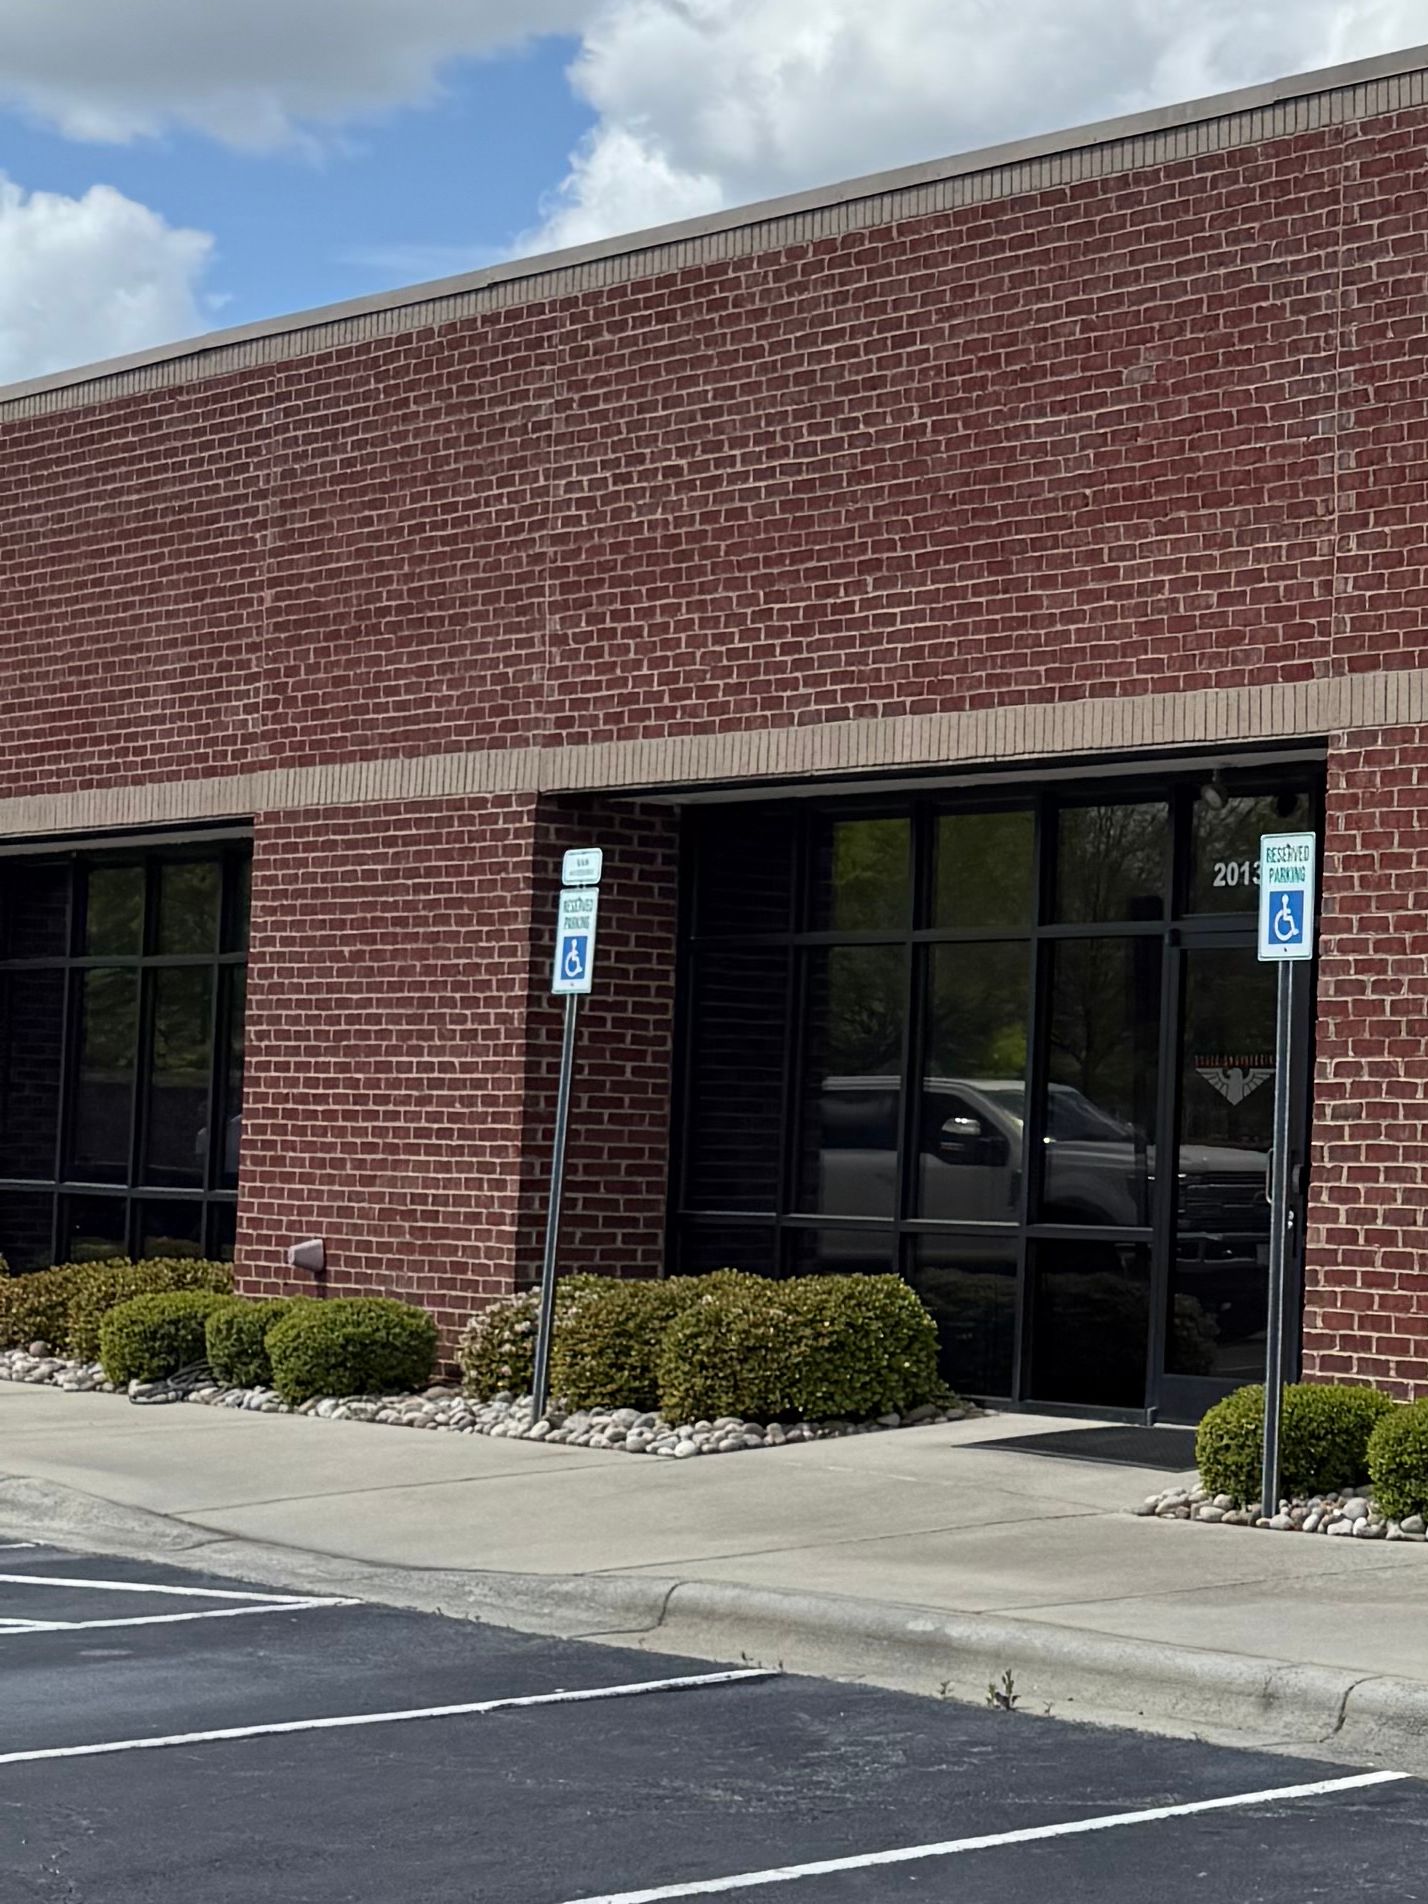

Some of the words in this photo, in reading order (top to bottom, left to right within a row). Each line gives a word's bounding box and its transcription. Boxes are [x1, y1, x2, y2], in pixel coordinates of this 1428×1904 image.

[1266, 845, 1310, 863] RESERVED
[1213, 861, 1261, 887] 2013
[1269, 866, 1306, 884] PARKING
